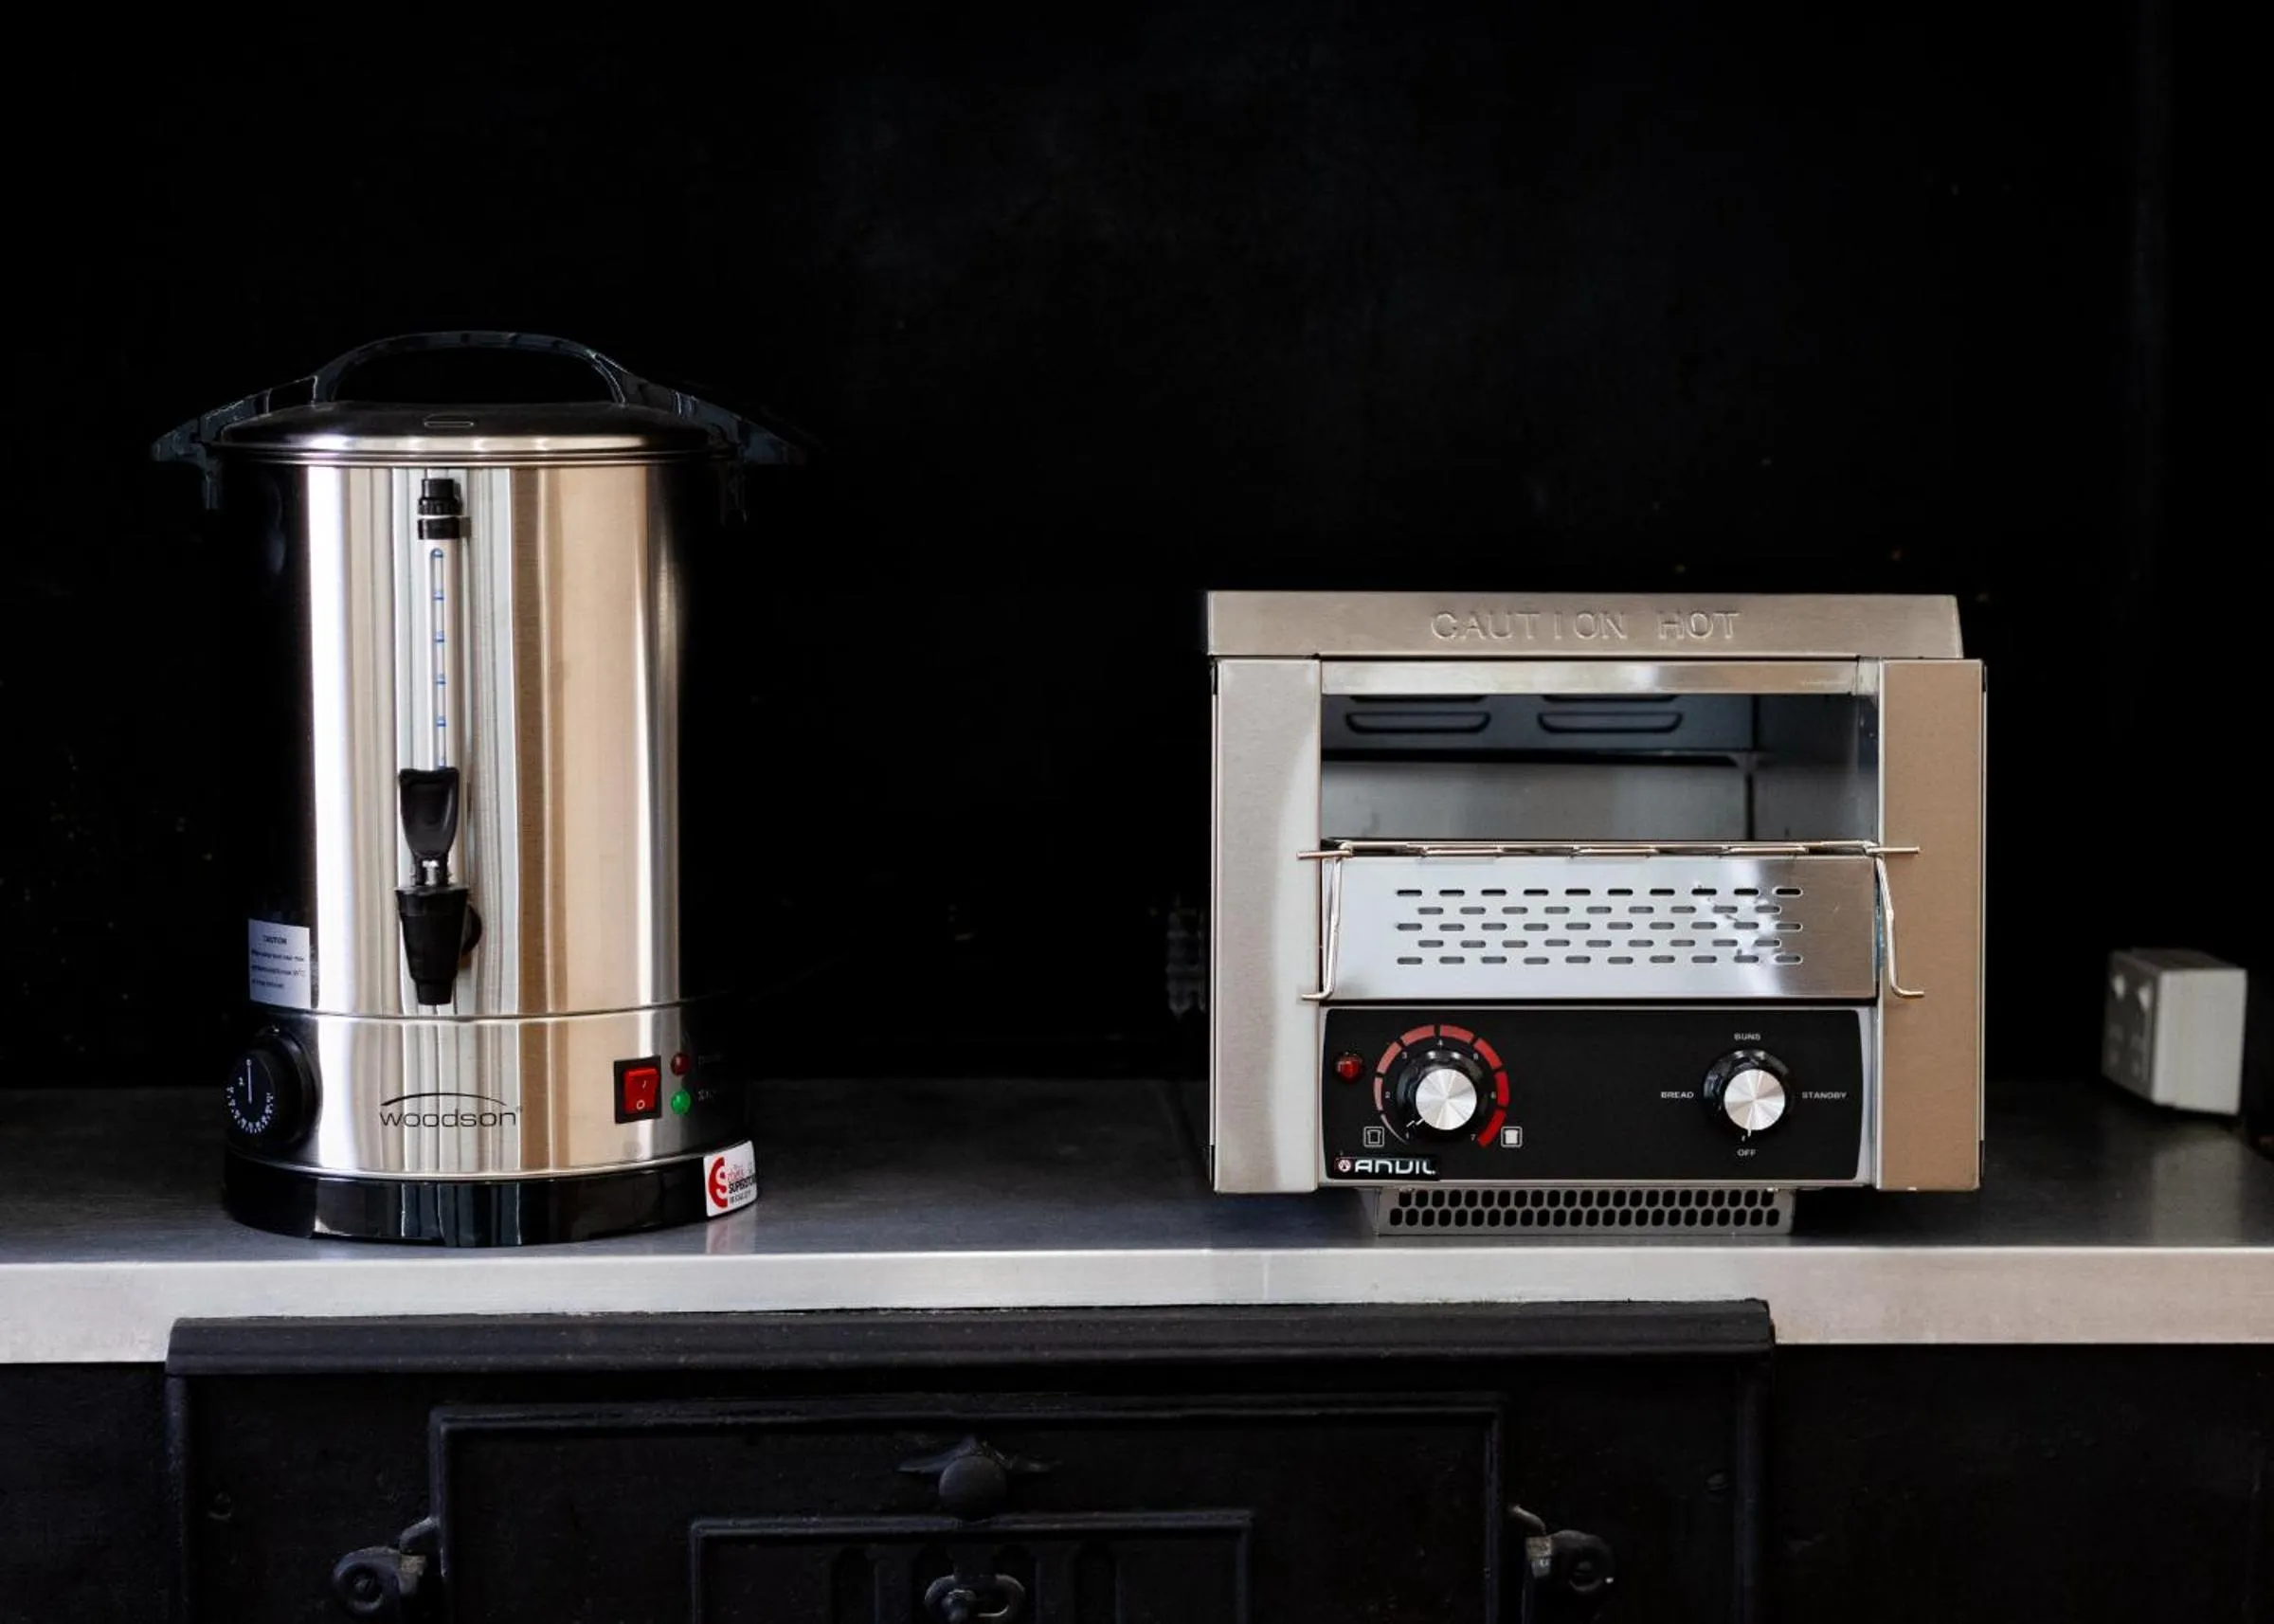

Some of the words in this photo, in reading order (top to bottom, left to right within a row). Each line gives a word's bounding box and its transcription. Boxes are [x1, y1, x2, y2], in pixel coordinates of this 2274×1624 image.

[1431, 611, 1629, 641] CAUTION
[1659, 611, 1741, 641] HOT
[1734, 1033, 1761, 1041] BUNS
[1660, 1091, 1695, 1100] BREAD
[1801, 1091, 1849, 1100] STANDBY
[379, 1108, 517, 1128] woodson
[1736, 1148, 1757, 1158] OFF
[1354, 1160, 1435, 1175] ANVIL
